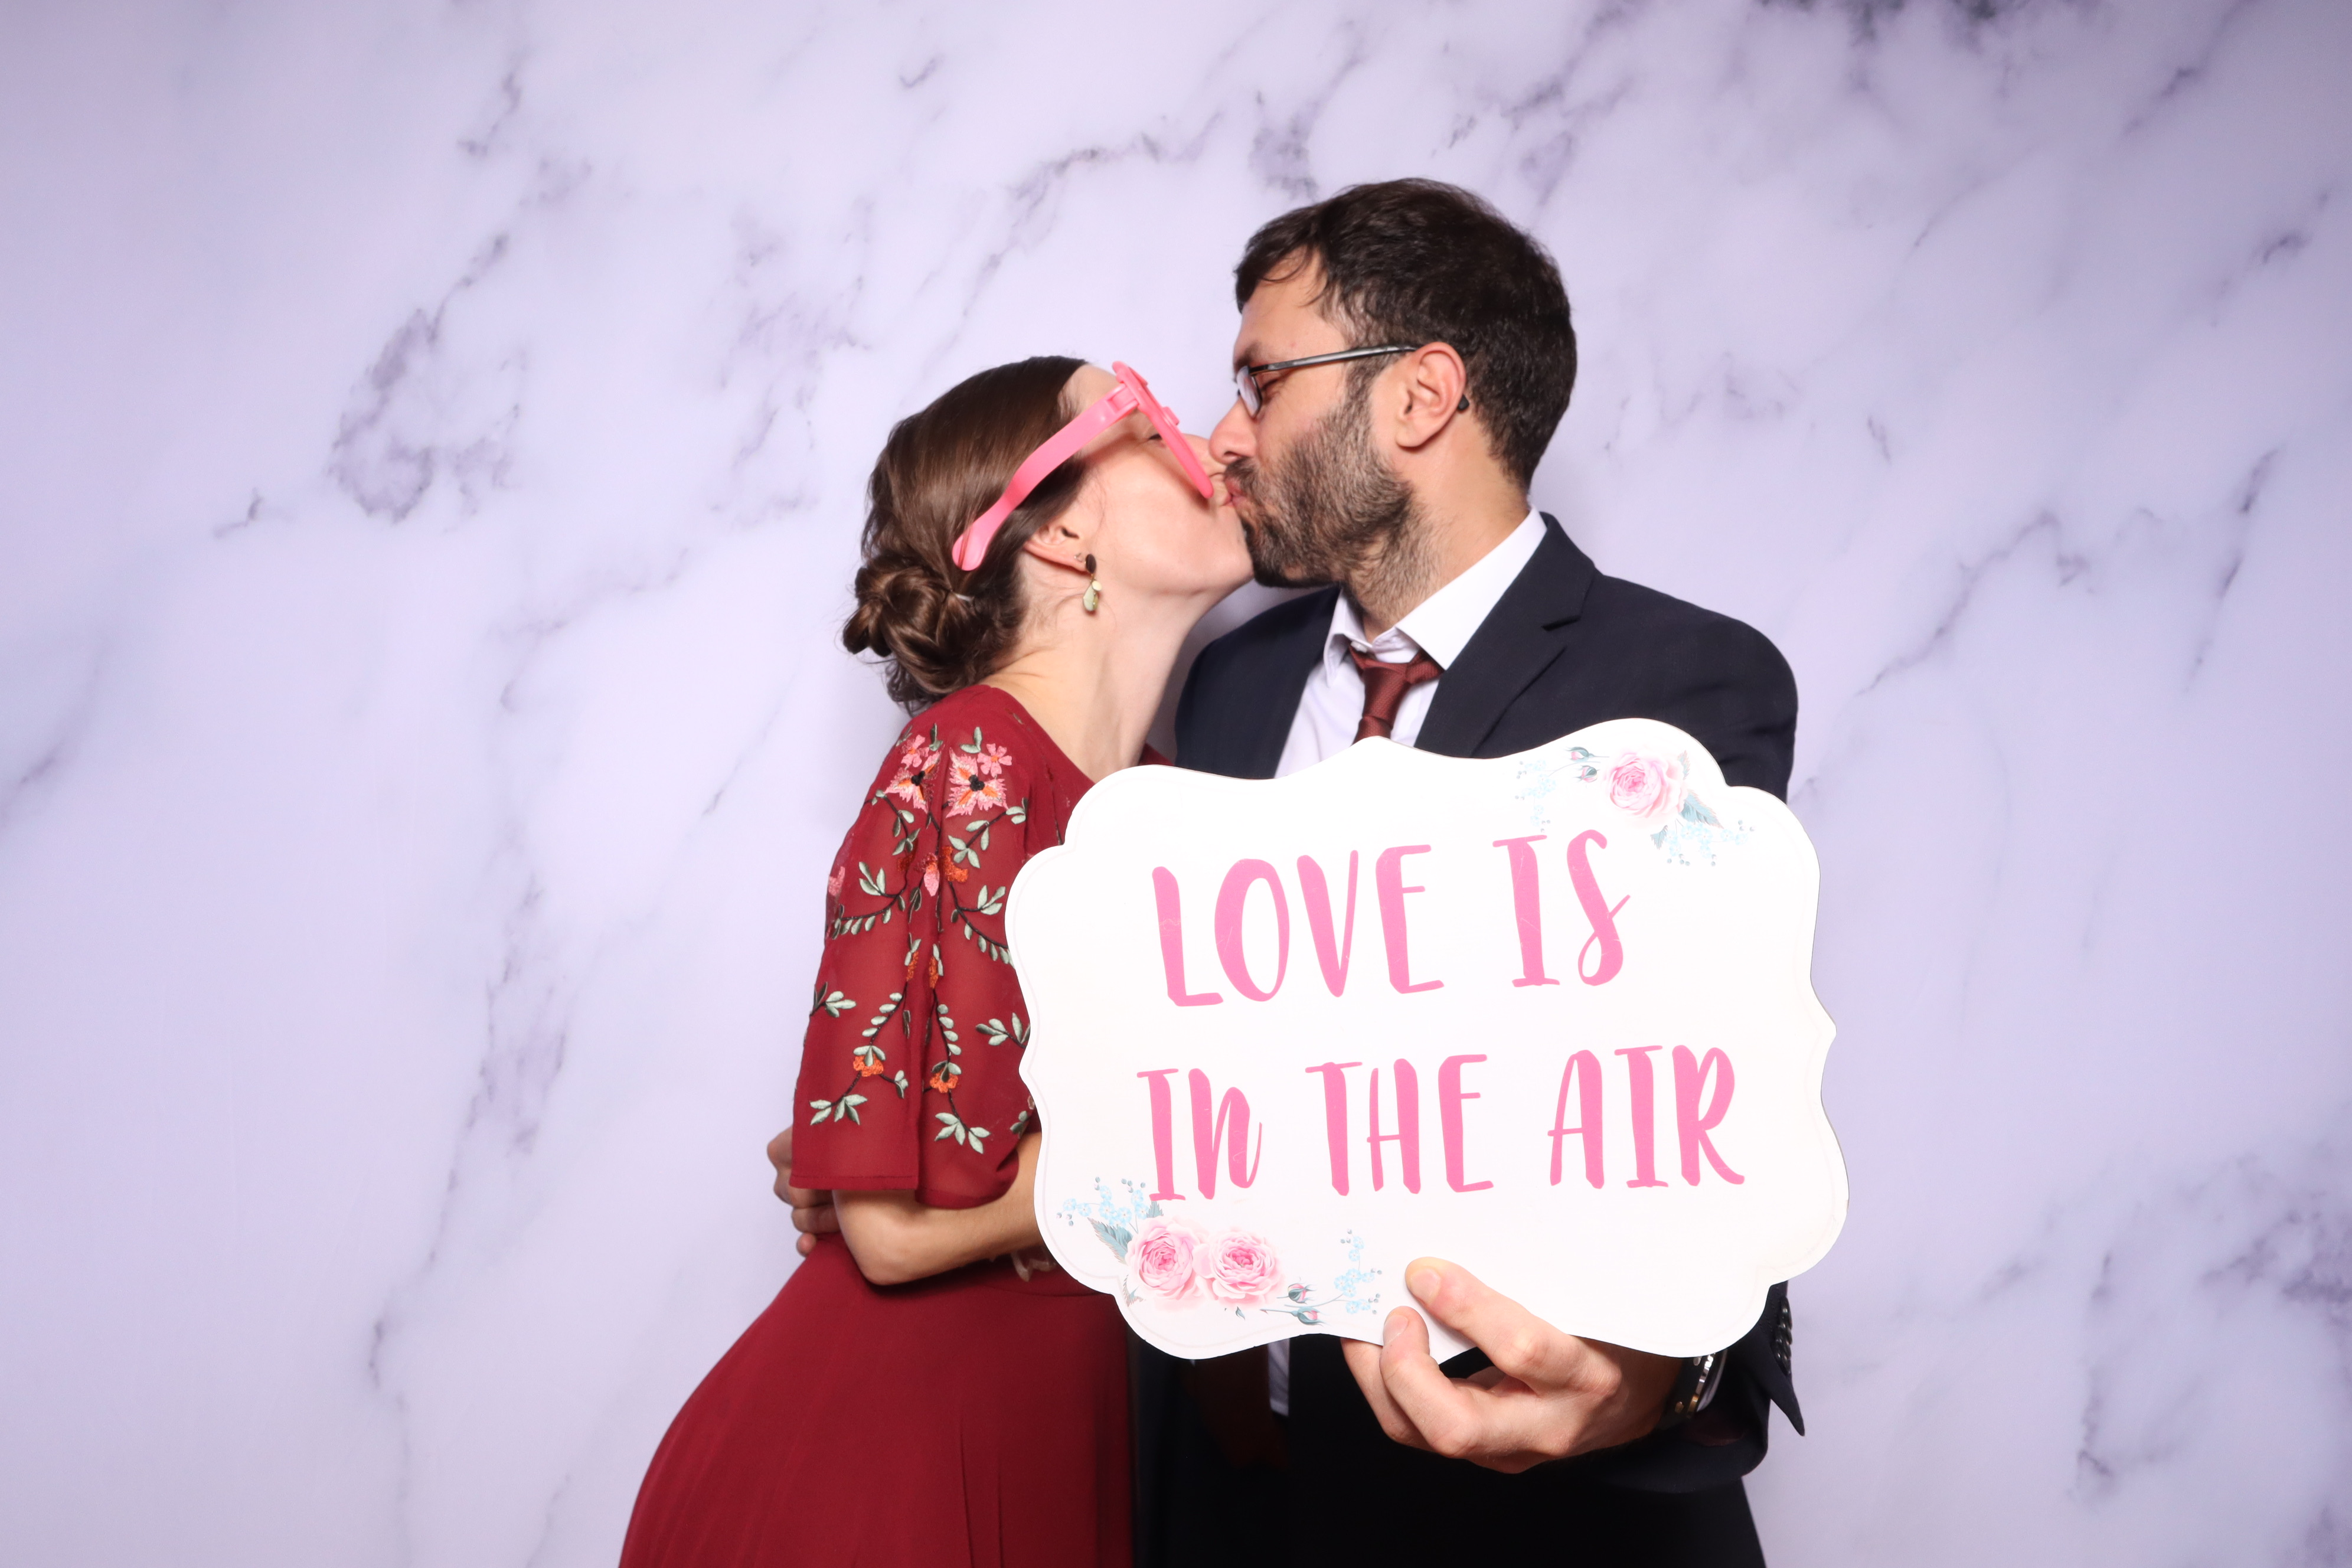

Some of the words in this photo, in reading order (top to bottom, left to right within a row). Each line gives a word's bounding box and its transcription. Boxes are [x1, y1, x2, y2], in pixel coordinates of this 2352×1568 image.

[1151, 844, 1445, 1008] LOVE
[1492, 829, 1631, 988] IS
[1305, 1053, 1495, 1197] THE
[1547, 1044, 1746, 1190] AIR
